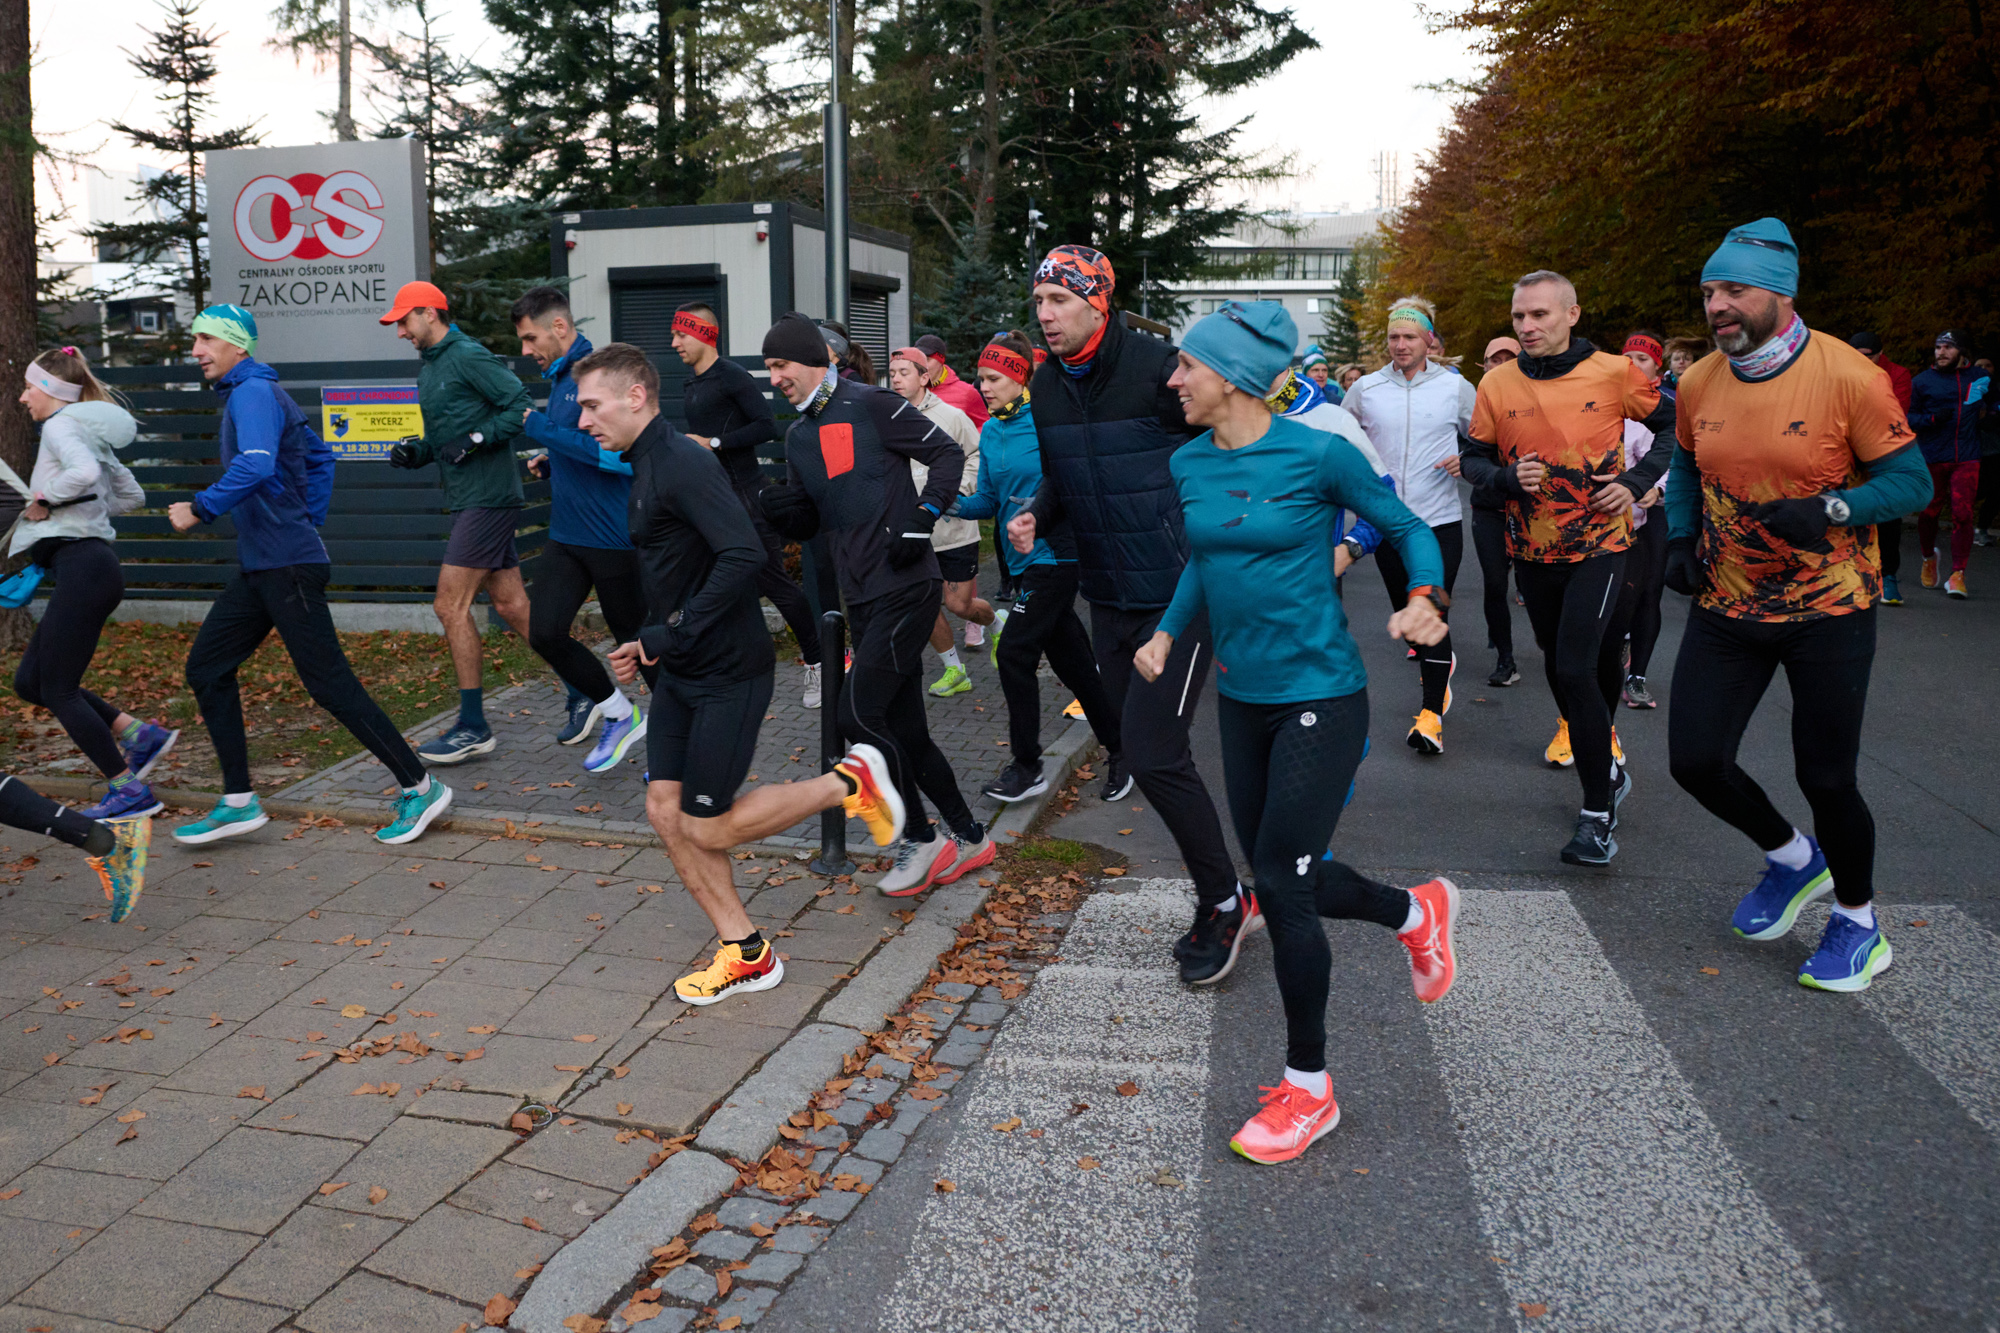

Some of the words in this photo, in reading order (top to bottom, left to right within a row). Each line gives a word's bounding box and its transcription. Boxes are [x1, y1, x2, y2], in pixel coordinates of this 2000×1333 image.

[238, 267, 295, 279] CENTRALNY
[298, 264, 345, 276] OŚRODEK
[348, 263, 385, 274] SPORTU
[239, 279, 386, 307] ZAKOPANE
[251, 310, 275, 319] RODEK
[326, 391, 357, 401] OBIEKT
[359, 391, 415, 401] CHRONIONY
[370, 417, 403, 426] RYCERZ
[332, 444, 344, 452] tel.
[346, 444, 356, 452] 18
[358, 444, 368, 452] 20
[370, 444, 381, 452] 79
[382, 444, 394, 452] 14
